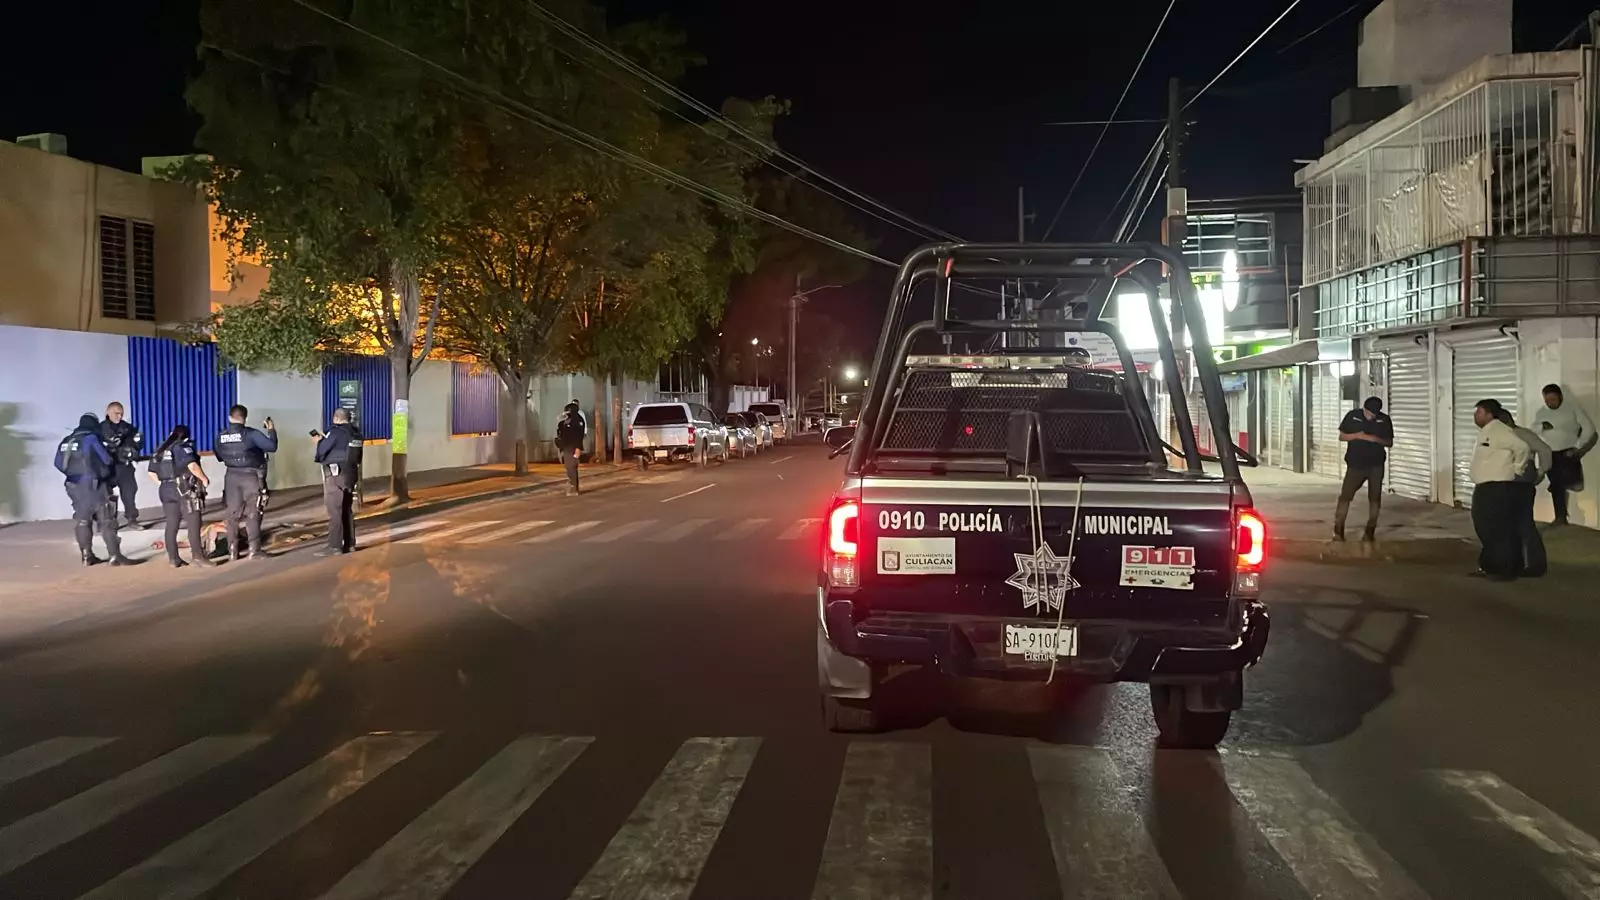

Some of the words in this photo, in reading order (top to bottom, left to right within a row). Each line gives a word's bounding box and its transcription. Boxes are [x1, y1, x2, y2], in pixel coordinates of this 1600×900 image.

[878, 510, 925, 531] 0910
[938, 508, 1003, 533] POLICÍA
[1083, 515, 1174, 536] MUNICIPAL
[1124, 569, 1191, 578] EMERGENCIAS
